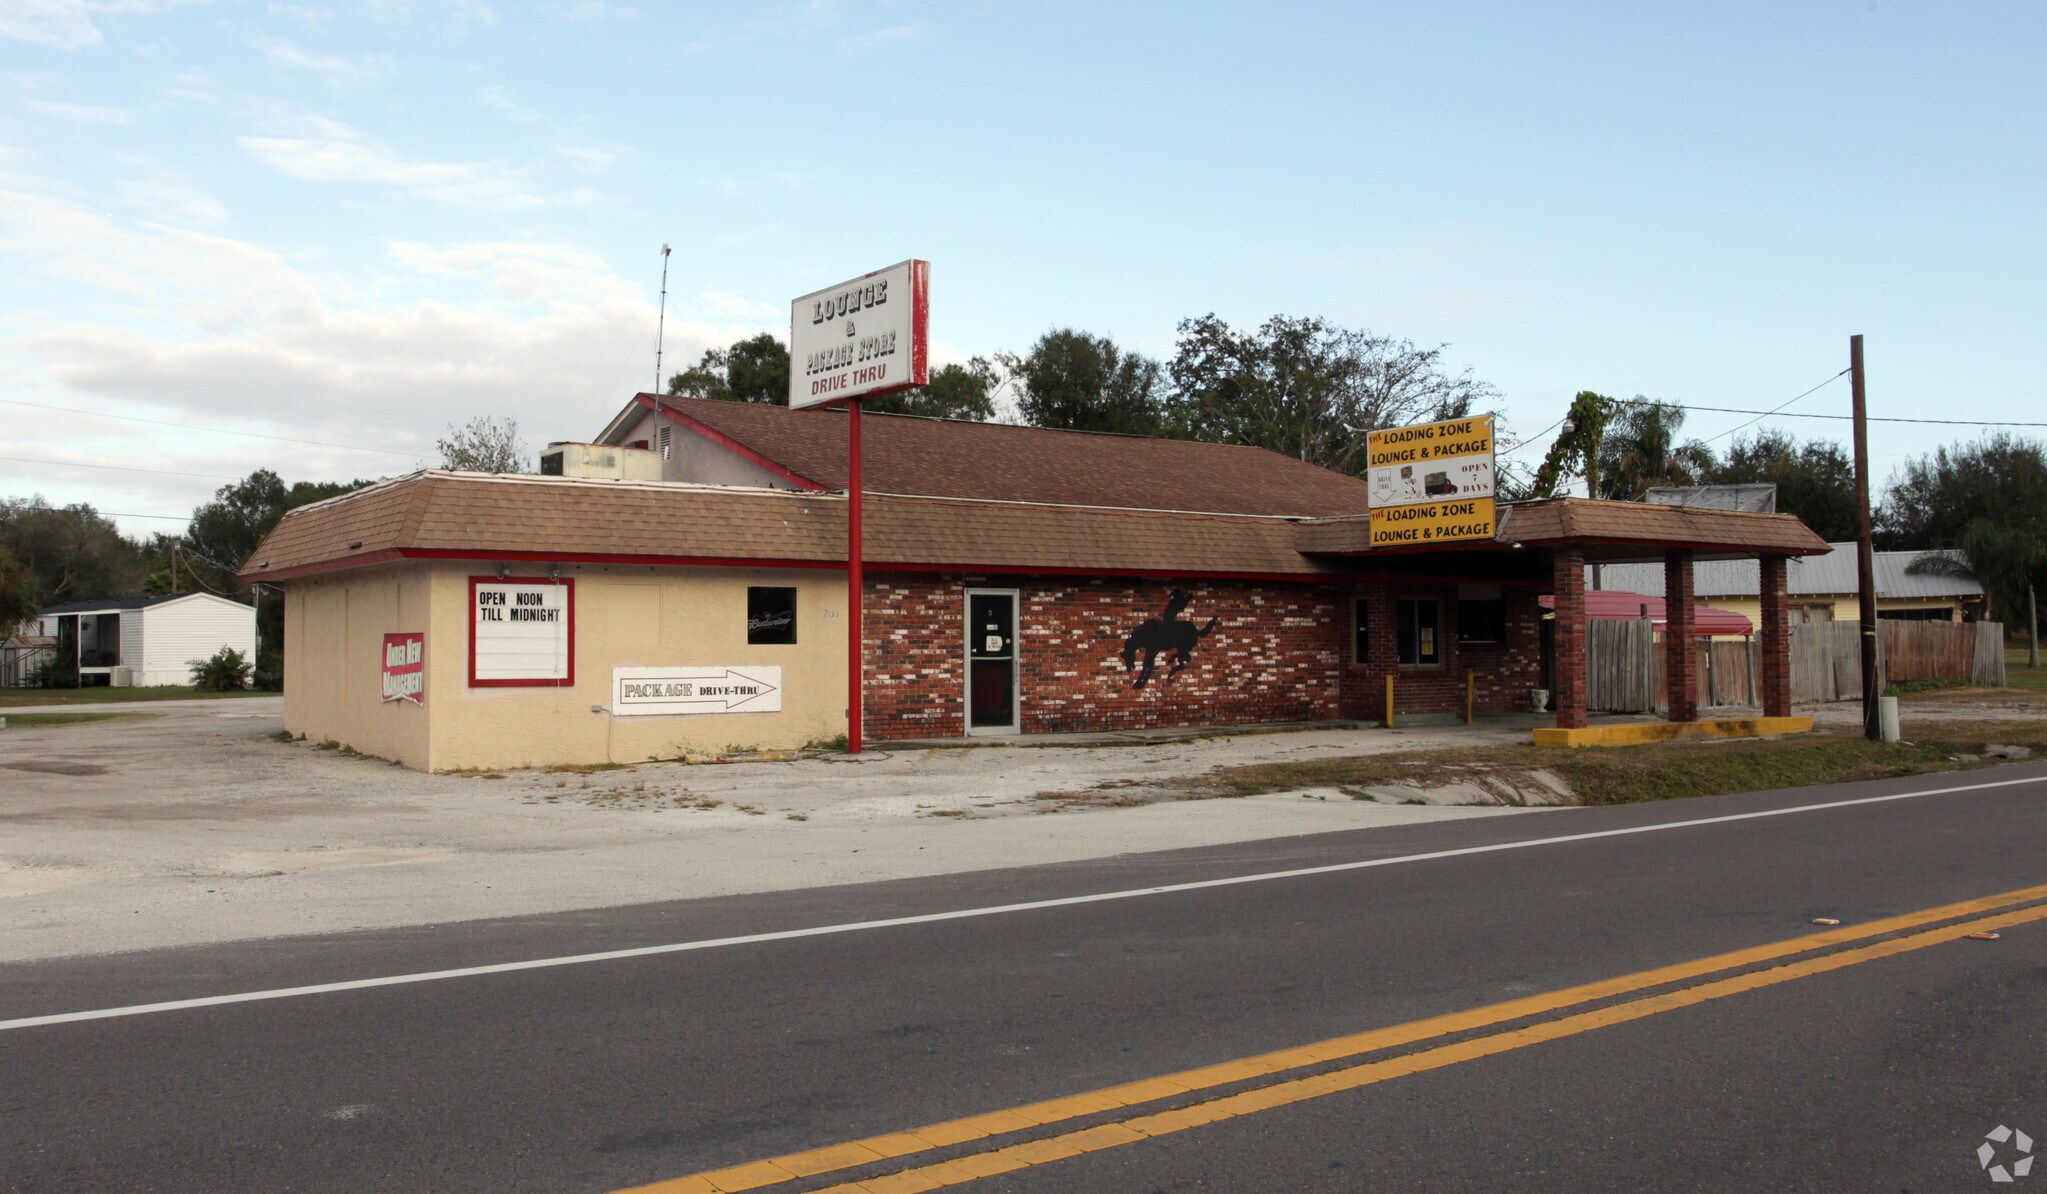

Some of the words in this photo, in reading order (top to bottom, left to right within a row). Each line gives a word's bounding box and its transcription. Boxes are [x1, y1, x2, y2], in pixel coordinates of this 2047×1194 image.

[812, 279, 888, 325] LOUNGE
[846, 320, 856, 337] &
[806, 342, 854, 376] PACKAGE
[858, 329, 896, 362] STORE
[812, 373, 848, 396] DRIVE
[853, 363, 887, 386] THRU
[1369, 433, 1382, 444] THE
[1384, 427, 1434, 444] LOADING
[1439, 422, 1472, 437] ZONE
[1371, 449, 1416, 465] LOUNGE
[1421, 447, 1430, 458] &
[1434, 439, 1488, 456] PACKAGE
[1461, 463, 1488, 473] OPEN
[1472, 474, 1477, 482] 7
[1463, 483, 1488, 493] DAYS
[1371, 509, 1385, 521] THE
[1386, 506, 1437, 521] LOADING
[1442, 503, 1475, 516] ZONE
[1374, 529, 1418, 542] LOUNGE
[1423, 527, 1432, 538] &
[1436, 523, 1490, 538] PACKAGE
[479, 592, 506, 605] OPEN
[516, 592, 543, 606] NOON
[481, 608, 503, 621] TILL
[510, 608, 560, 622] MIDNIGHT
[386, 642, 406, 667] UNDER
[406, 638, 422, 665] NEW
[624, 683, 693, 698] PACKAGE
[699, 686, 760, 696] DRIVE-THRU
